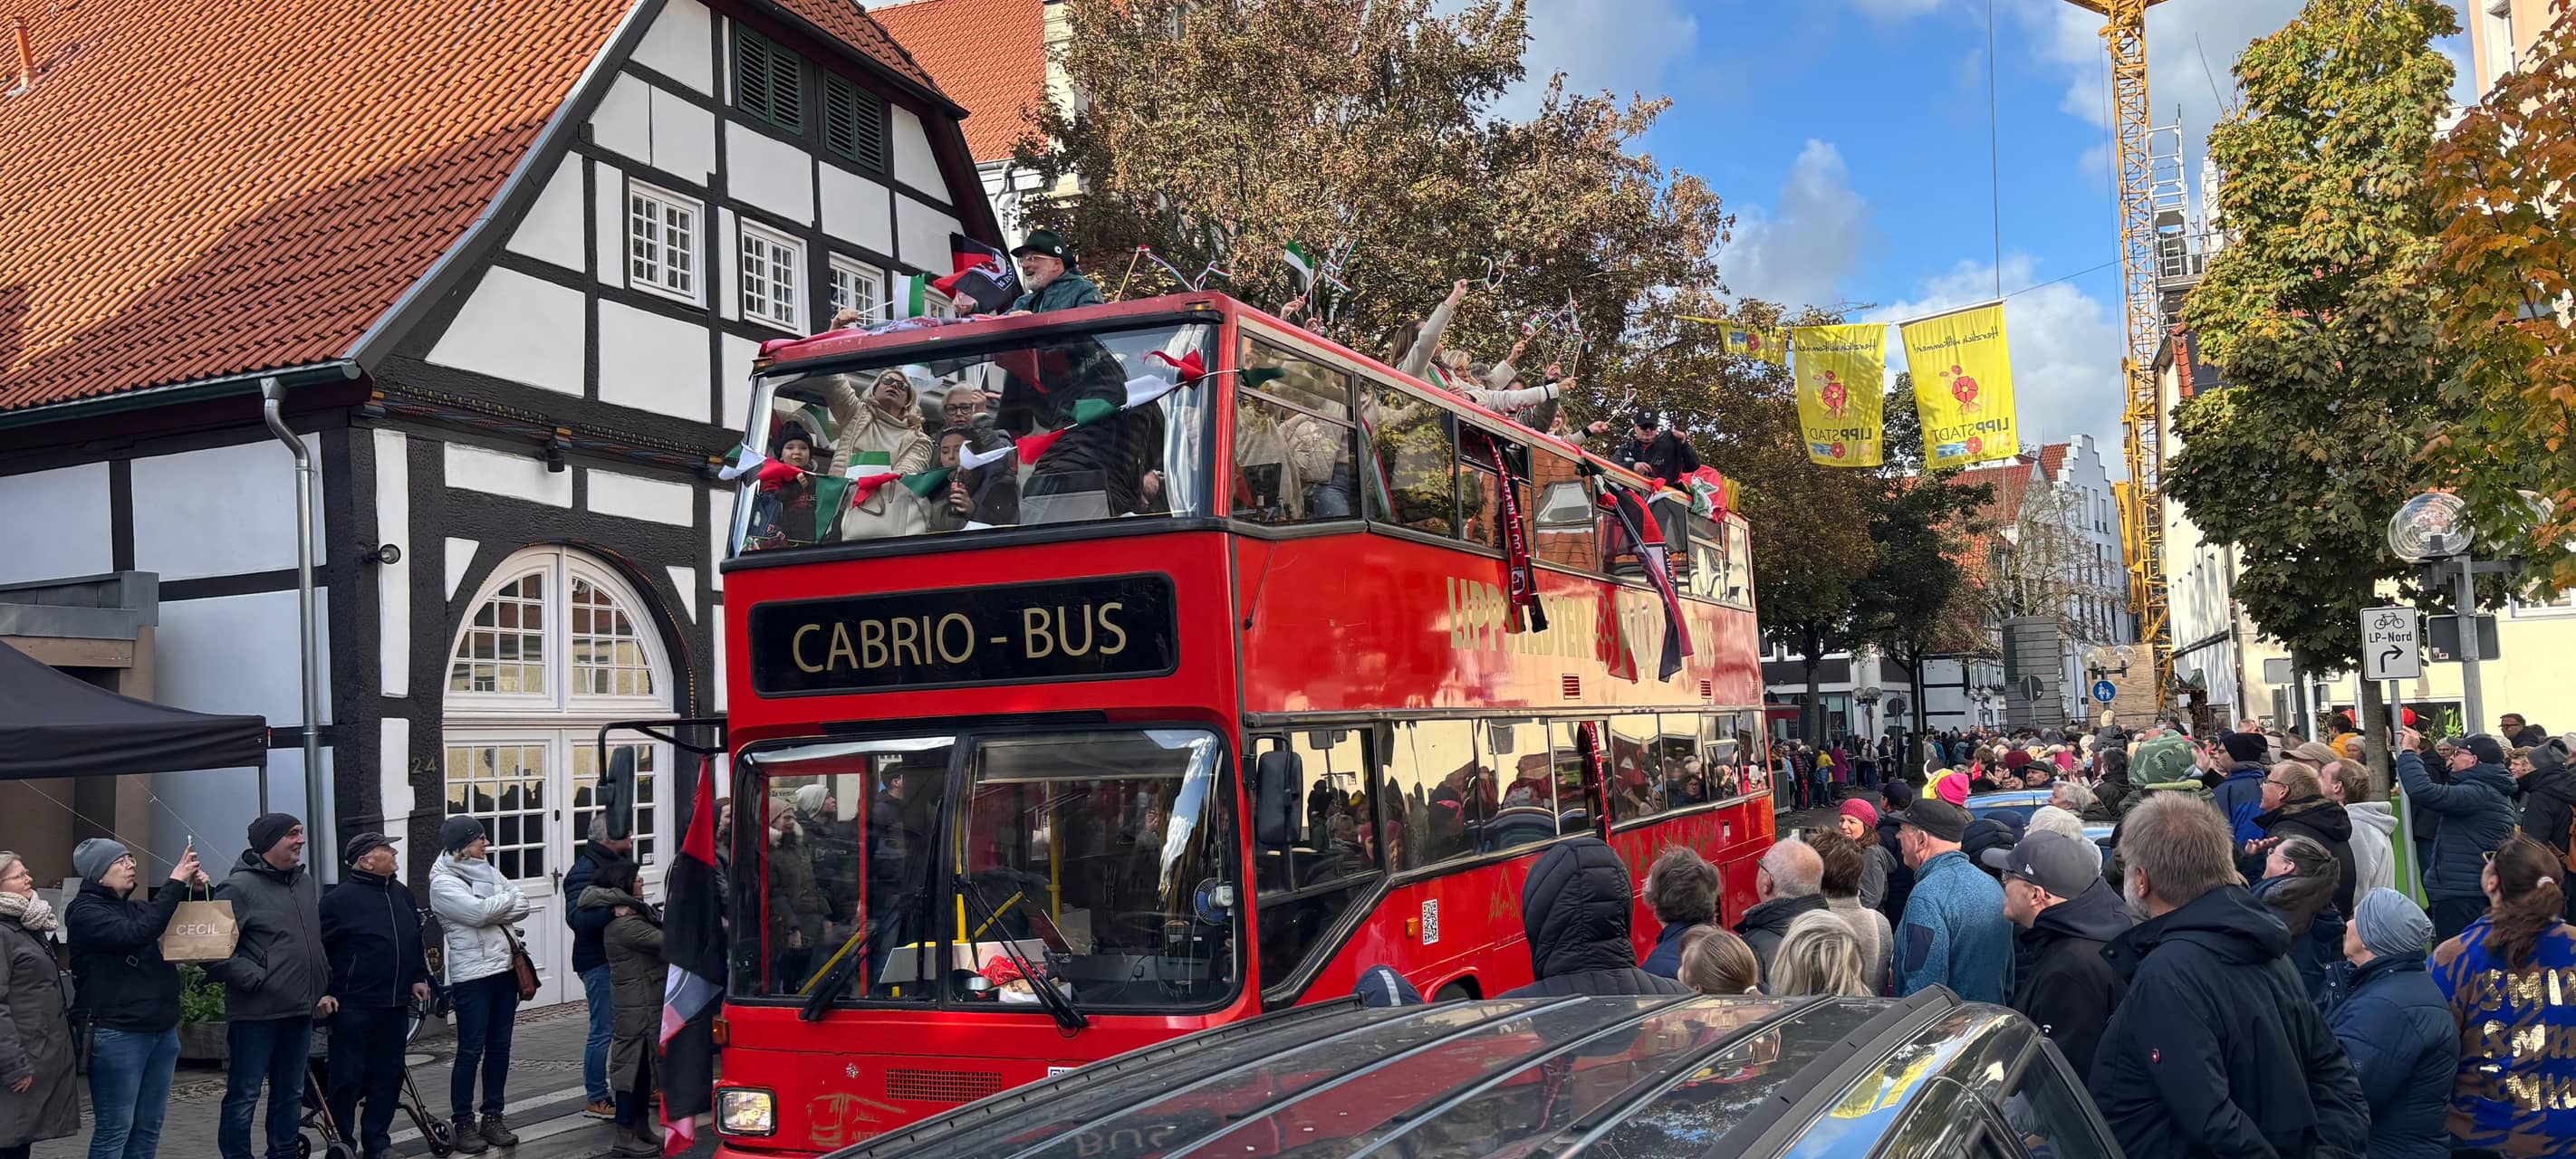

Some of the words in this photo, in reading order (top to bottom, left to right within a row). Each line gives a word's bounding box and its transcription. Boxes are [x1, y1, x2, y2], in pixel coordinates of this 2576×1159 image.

[793, 612, 975, 673] CABRIO
[1024, 602, 1126, 658] BUS
[2369, 631, 2413, 643] LP-Nord
[412, 757, 437, 773] 24
[177, 924, 218, 934] CECIL
